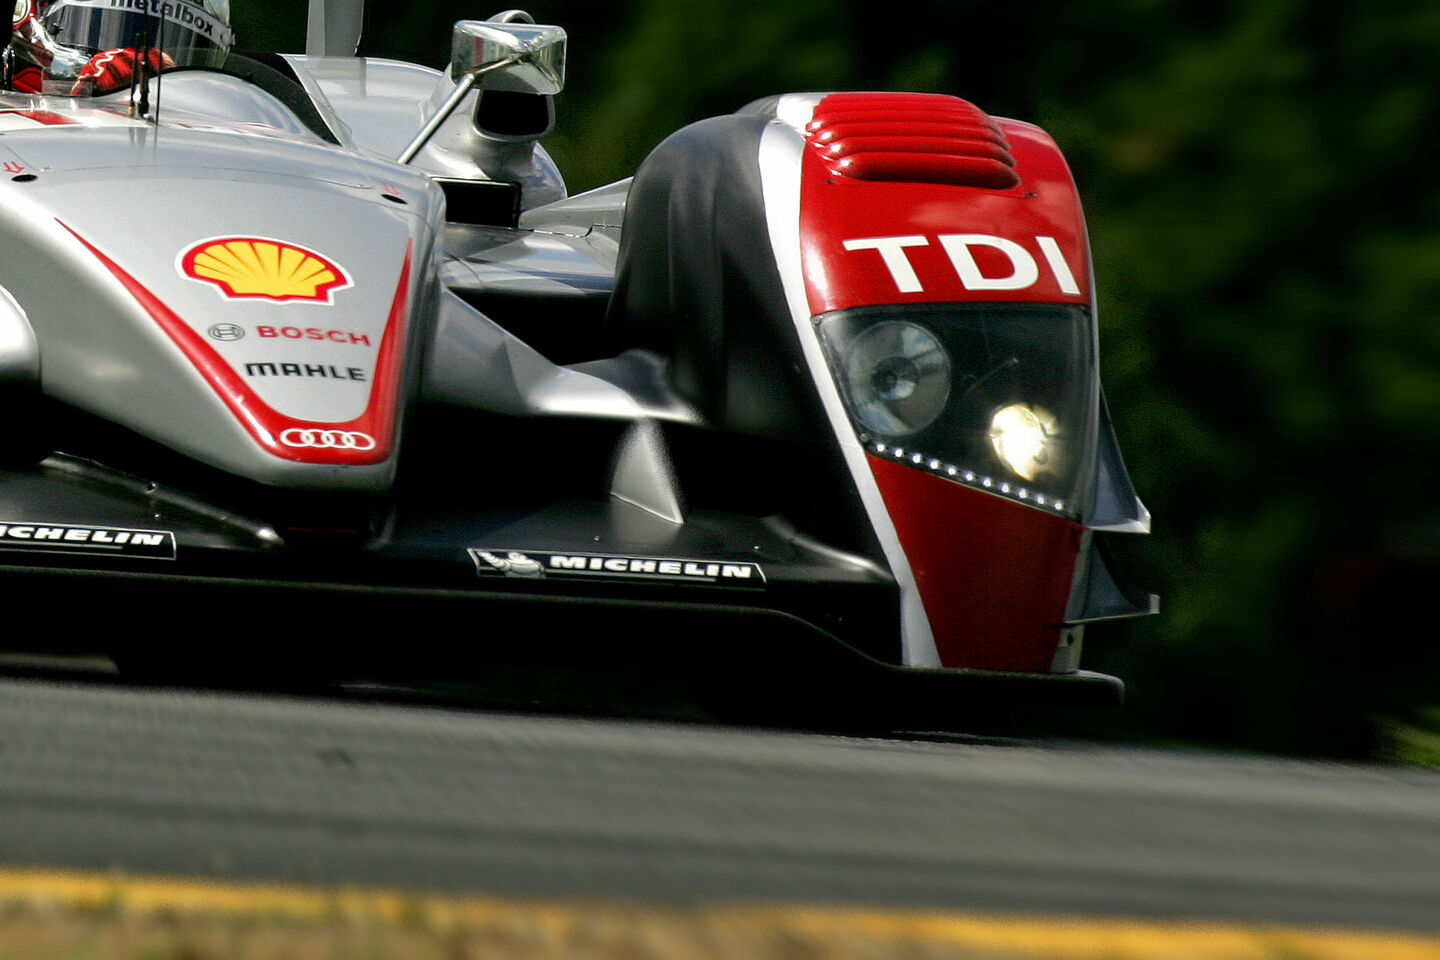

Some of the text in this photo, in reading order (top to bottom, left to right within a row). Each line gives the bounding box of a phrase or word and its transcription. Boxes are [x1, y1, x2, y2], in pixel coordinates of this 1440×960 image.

[842, 234, 1081, 295] TDI
[256, 325, 372, 347] BOSCH
[244, 362, 367, 382] MAHLE
[550, 555, 752, 579] MICHELIN
